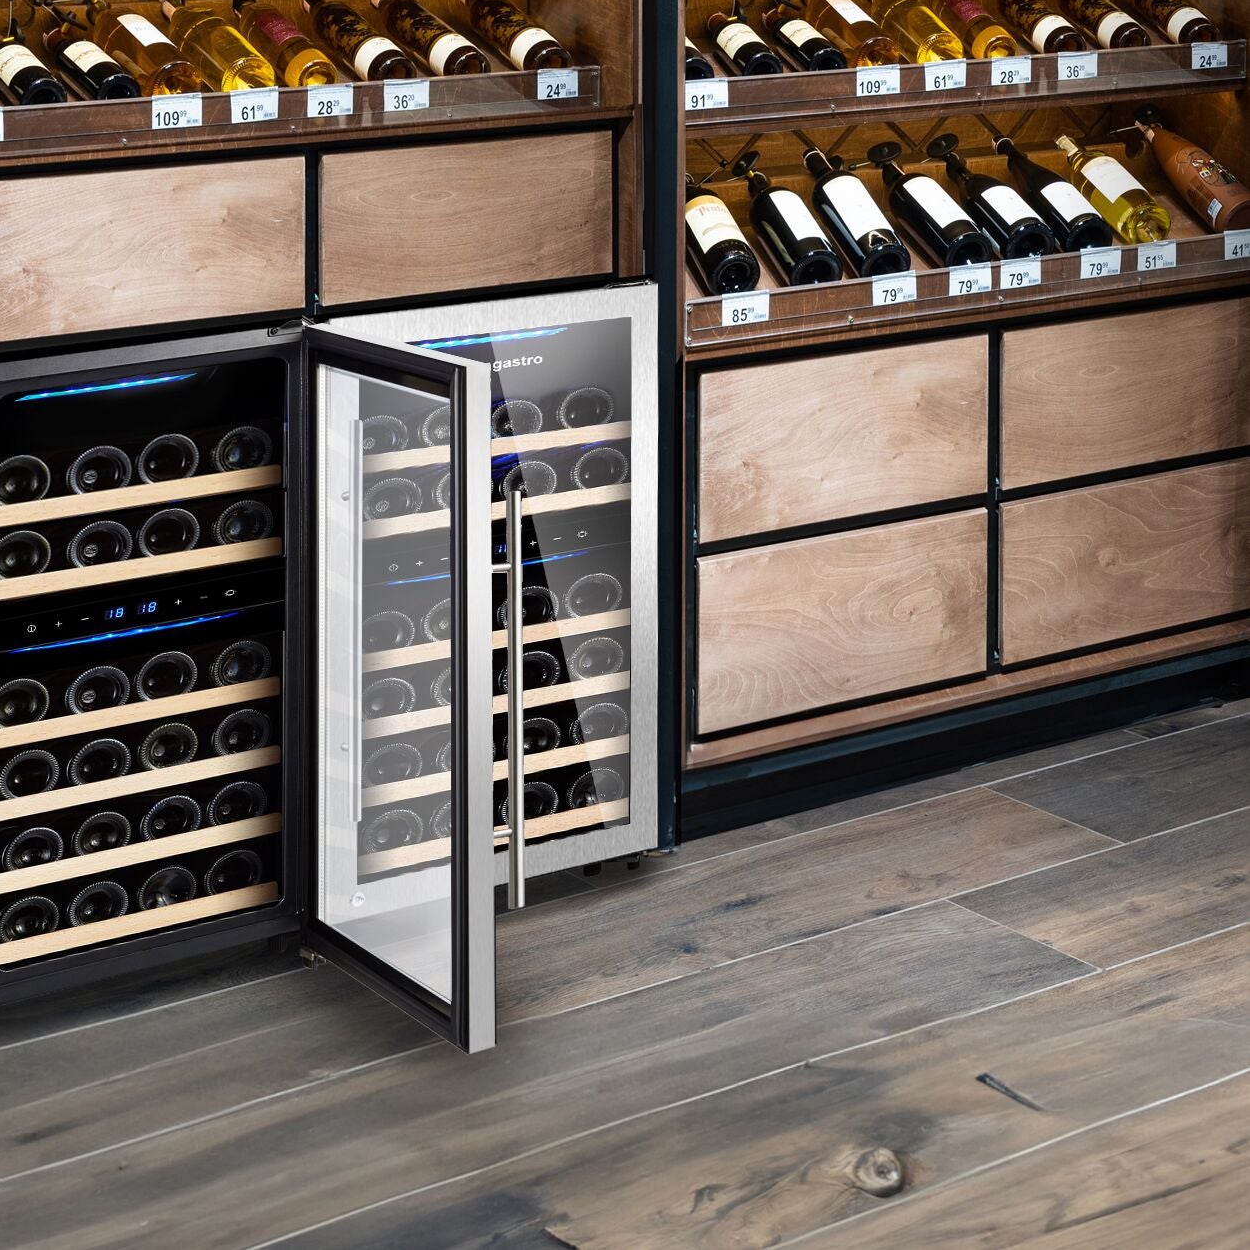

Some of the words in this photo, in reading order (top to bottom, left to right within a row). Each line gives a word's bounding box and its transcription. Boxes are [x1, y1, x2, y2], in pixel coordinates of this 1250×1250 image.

[492, 355, 543, 373] gastro
[110, 607, 124, 619] 18
[142, 601, 157, 613] 18
